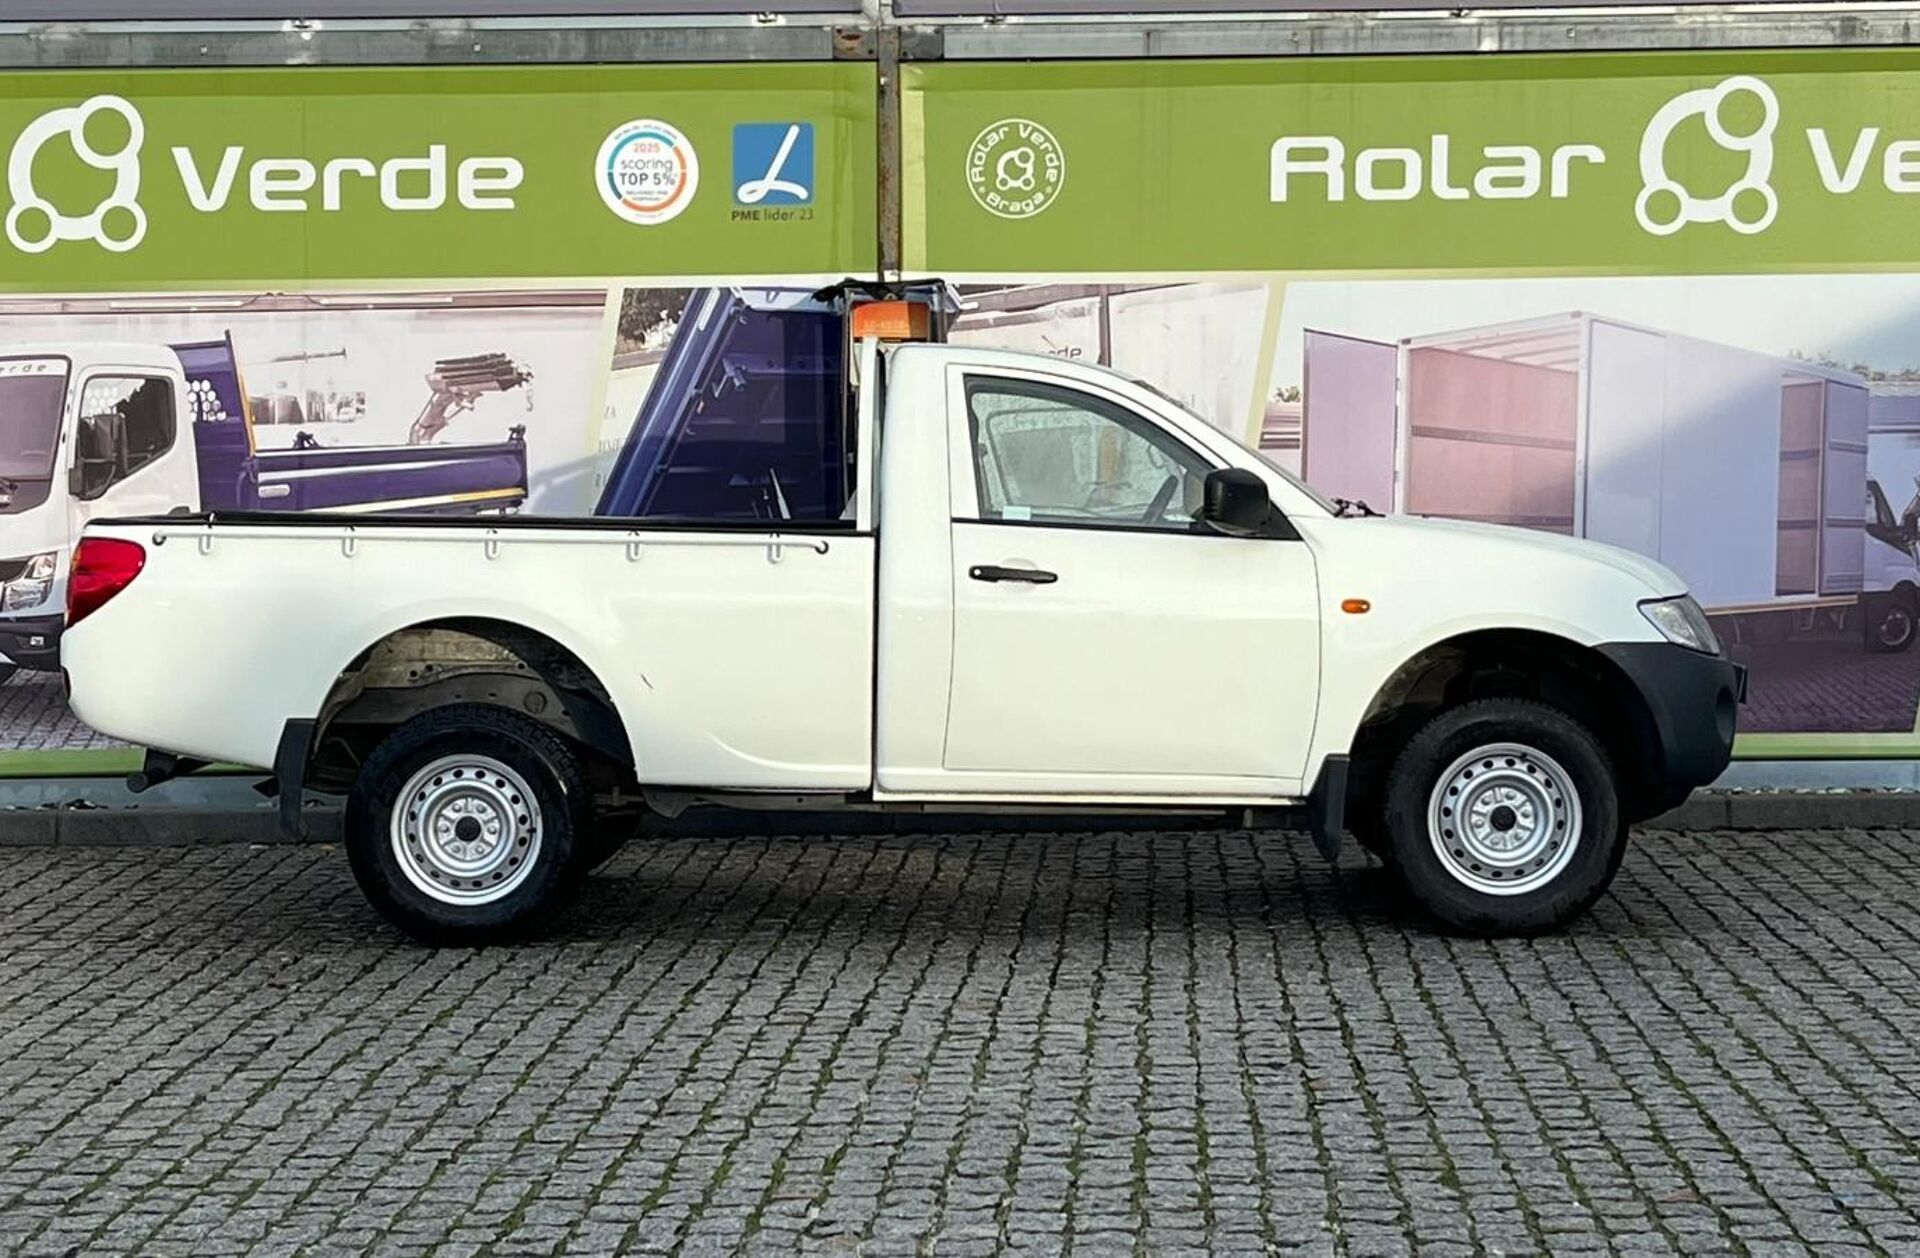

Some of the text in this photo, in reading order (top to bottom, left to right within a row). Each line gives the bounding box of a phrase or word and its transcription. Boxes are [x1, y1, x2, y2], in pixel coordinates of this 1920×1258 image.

[633, 142, 661, 153] 2025
[971, 123, 1060, 183] Rolar Verde
[621, 158, 673, 173] scoring
[1270, 127, 1920, 202] Rolar Ve
[171, 144, 524, 212] Verde
[620, 172, 676, 186] TOP 5%
[986, 191, 1045, 212] Braga
[731, 209, 760, 221] PME
